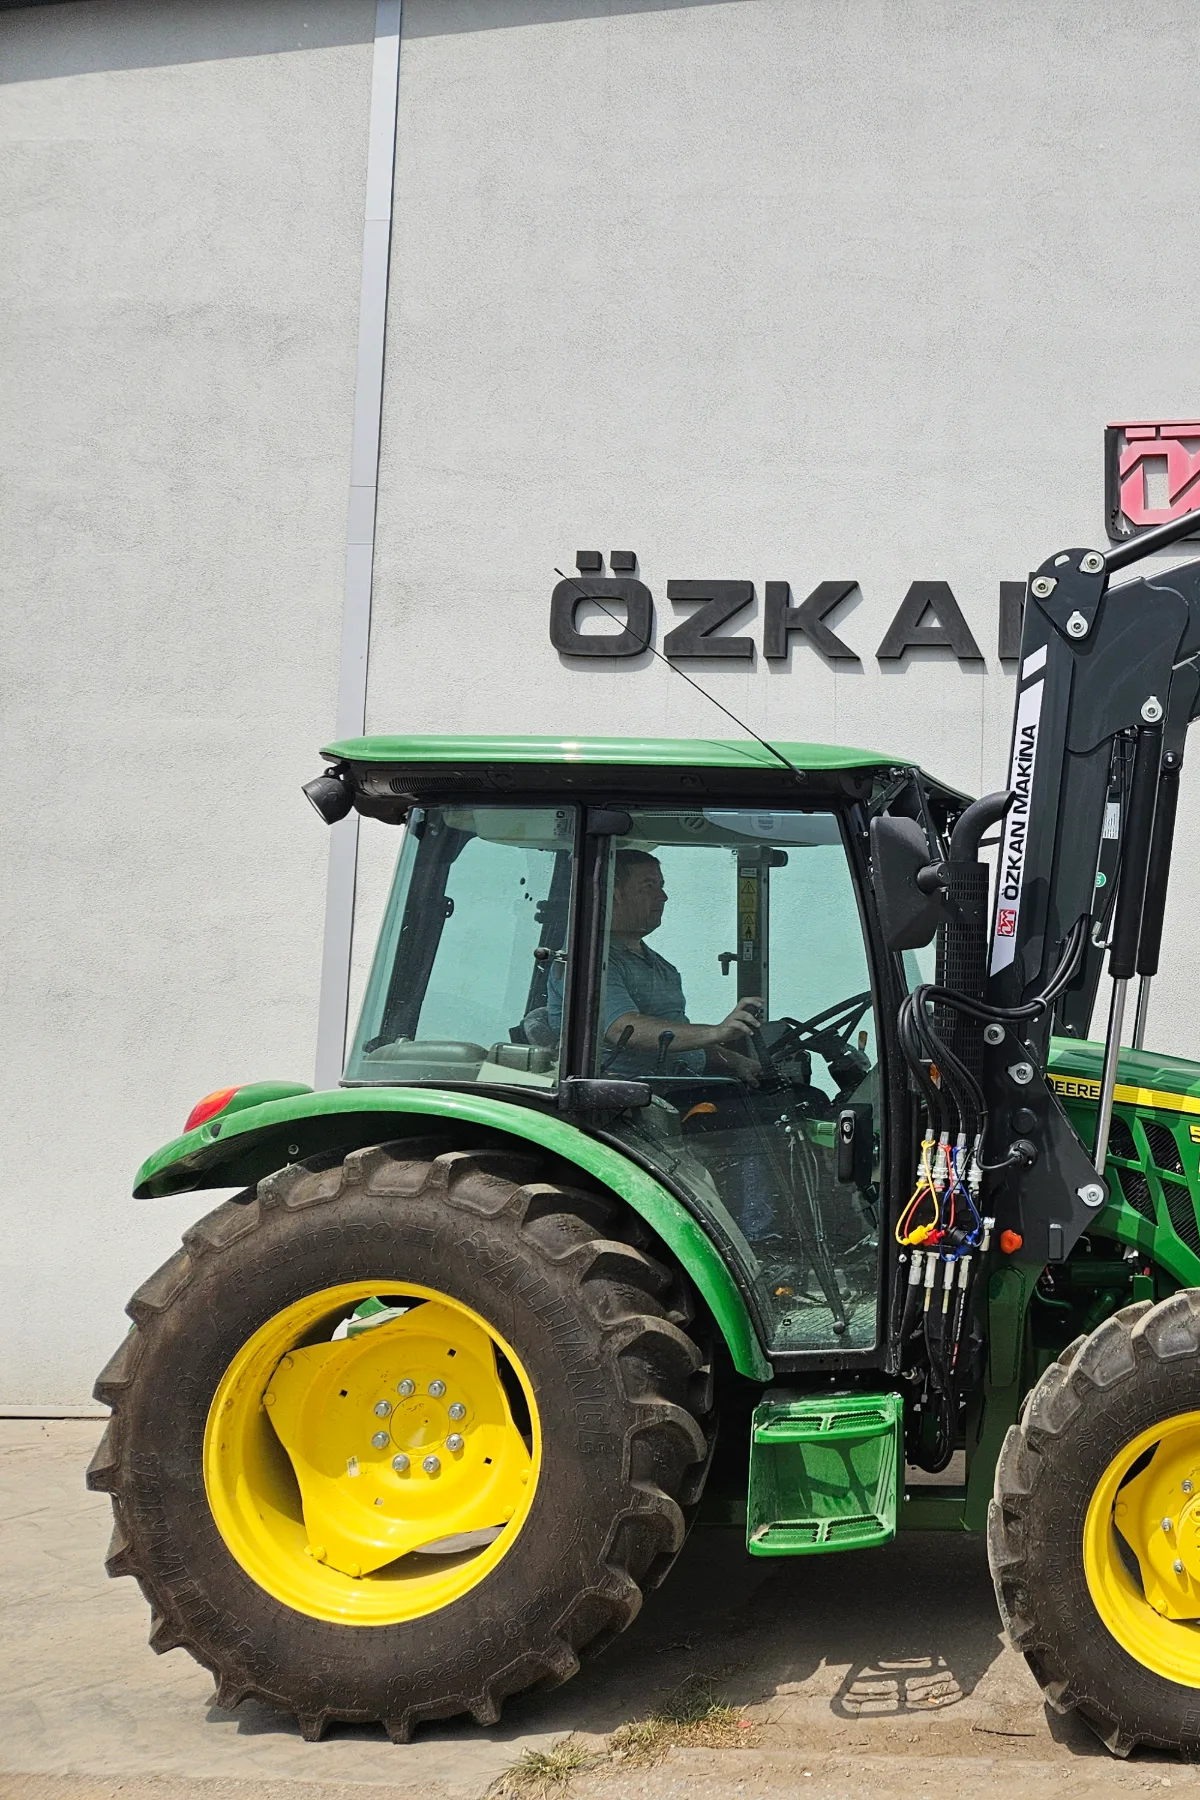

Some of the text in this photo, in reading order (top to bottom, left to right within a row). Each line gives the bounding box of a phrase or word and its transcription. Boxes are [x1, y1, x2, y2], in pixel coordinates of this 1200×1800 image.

[549, 550, 1027, 660] ÖZKA
[1012, 724, 1037, 815] MAKİNA
[1001, 820, 1026, 902] ÖZKAN
[482, 1254, 616, 1454] ALLIANCE
